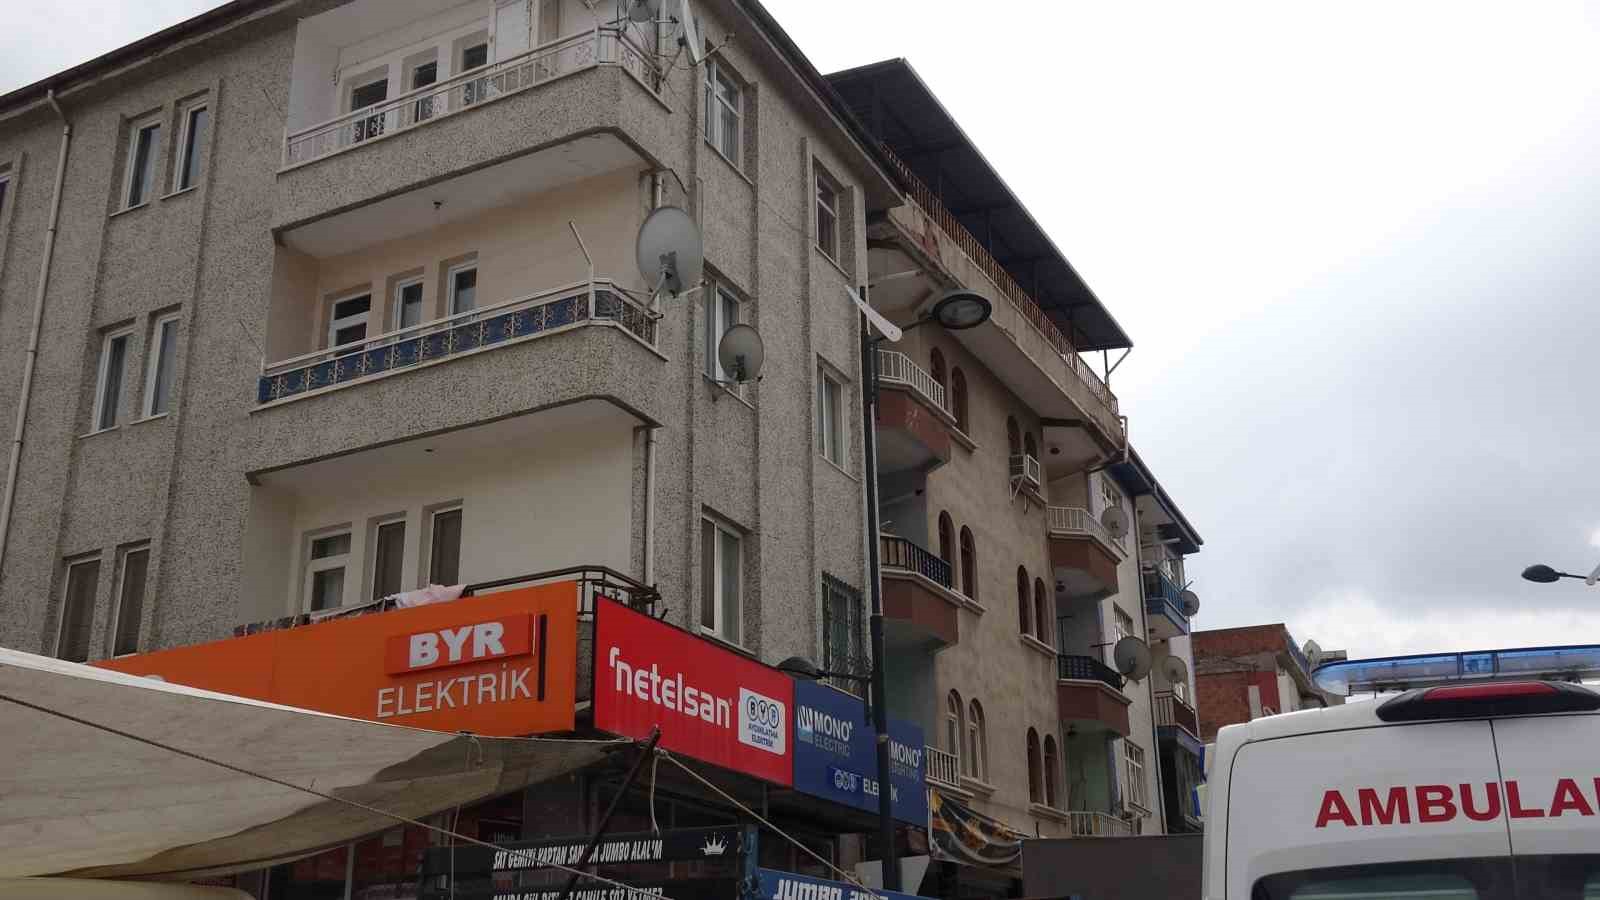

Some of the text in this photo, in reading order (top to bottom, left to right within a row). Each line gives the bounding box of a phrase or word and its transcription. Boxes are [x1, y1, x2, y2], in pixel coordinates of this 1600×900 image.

[409, 622, 505, 668] BYR
[376, 663, 532, 718] ELEKTRİK
[609, 646, 730, 729] netelsan
[814, 711, 850, 742] MONO
[815, 735, 851, 757] ELECTRIC
[890, 740, 920, 768] MONO
[1315, 777, 1600, 828] AMBULA
[493, 850, 508, 870] SAT
[600, 841, 630, 863] JUMBO
